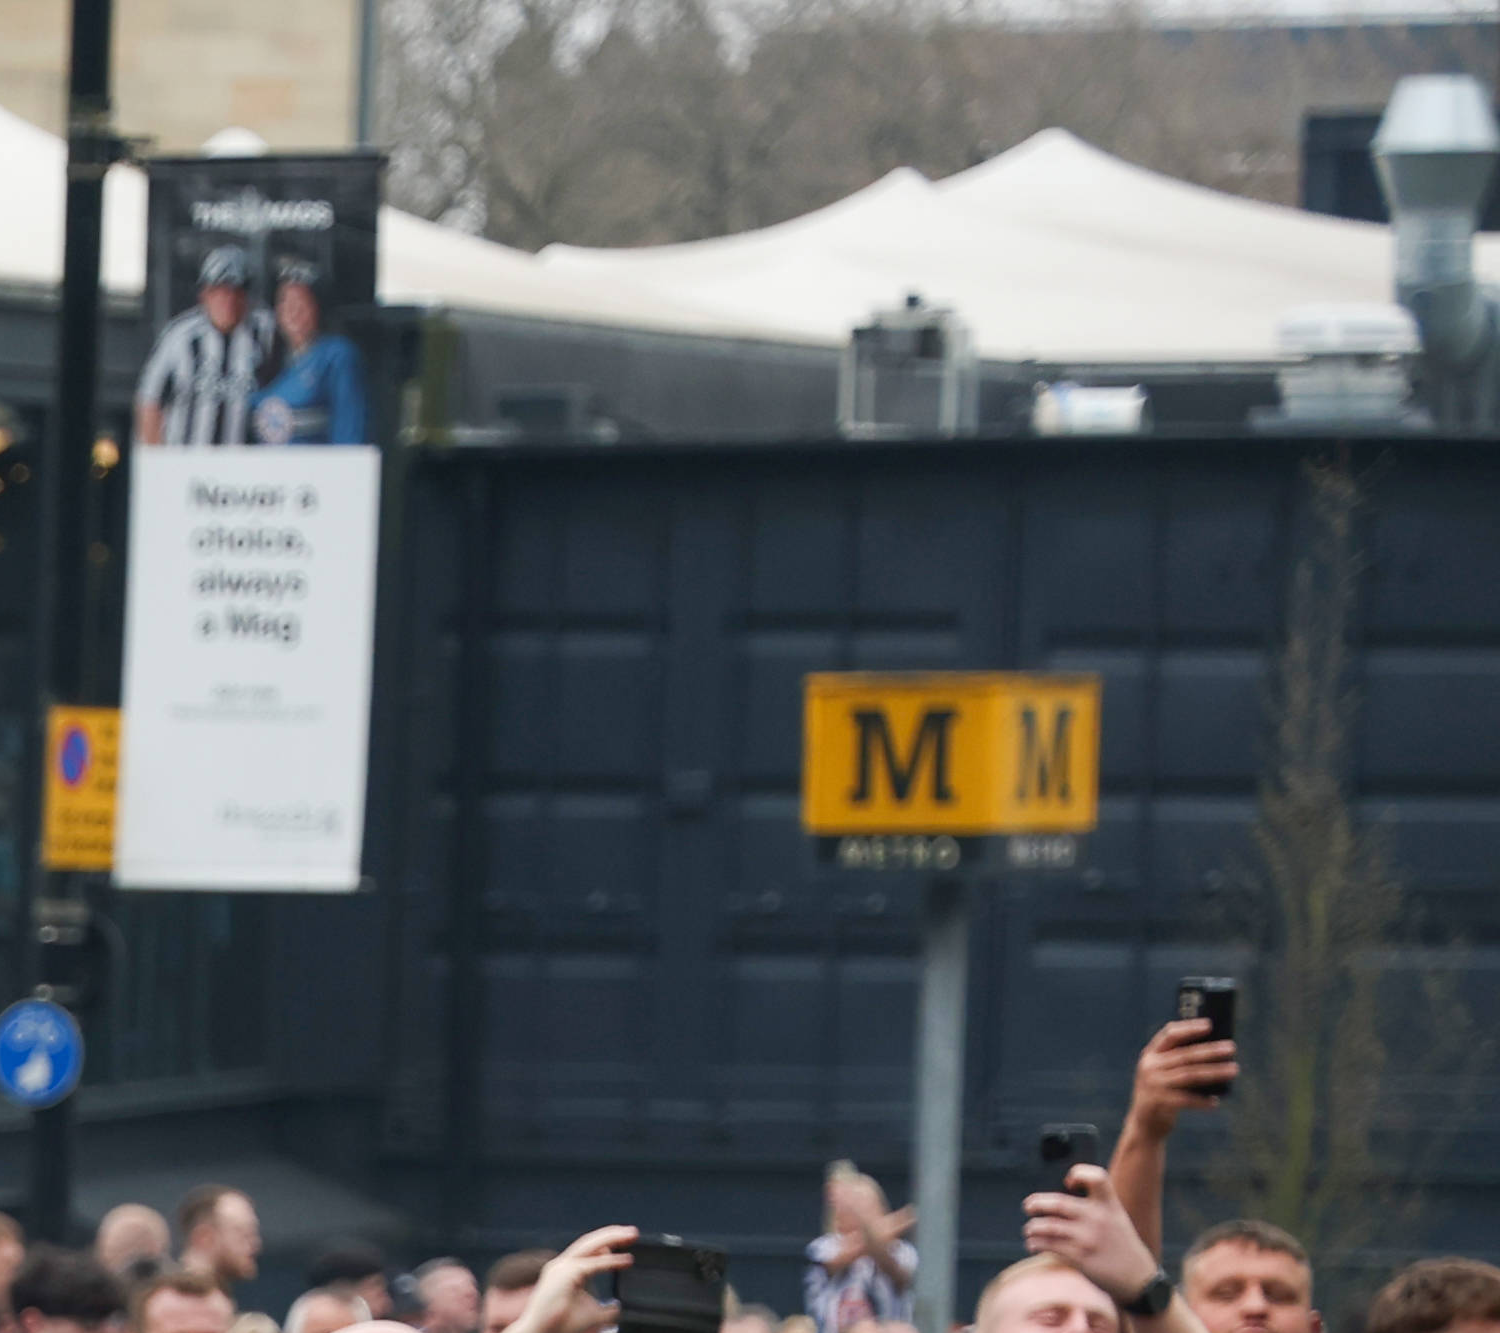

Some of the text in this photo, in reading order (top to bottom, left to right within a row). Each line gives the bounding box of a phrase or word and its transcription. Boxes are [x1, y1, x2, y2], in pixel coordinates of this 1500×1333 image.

[190, 480, 320, 509] Never a
[194, 569, 307, 604] always
[196, 610, 300, 645] a Mag
[850, 706, 957, 804] M
[1017, 707, 1071, 804] M
